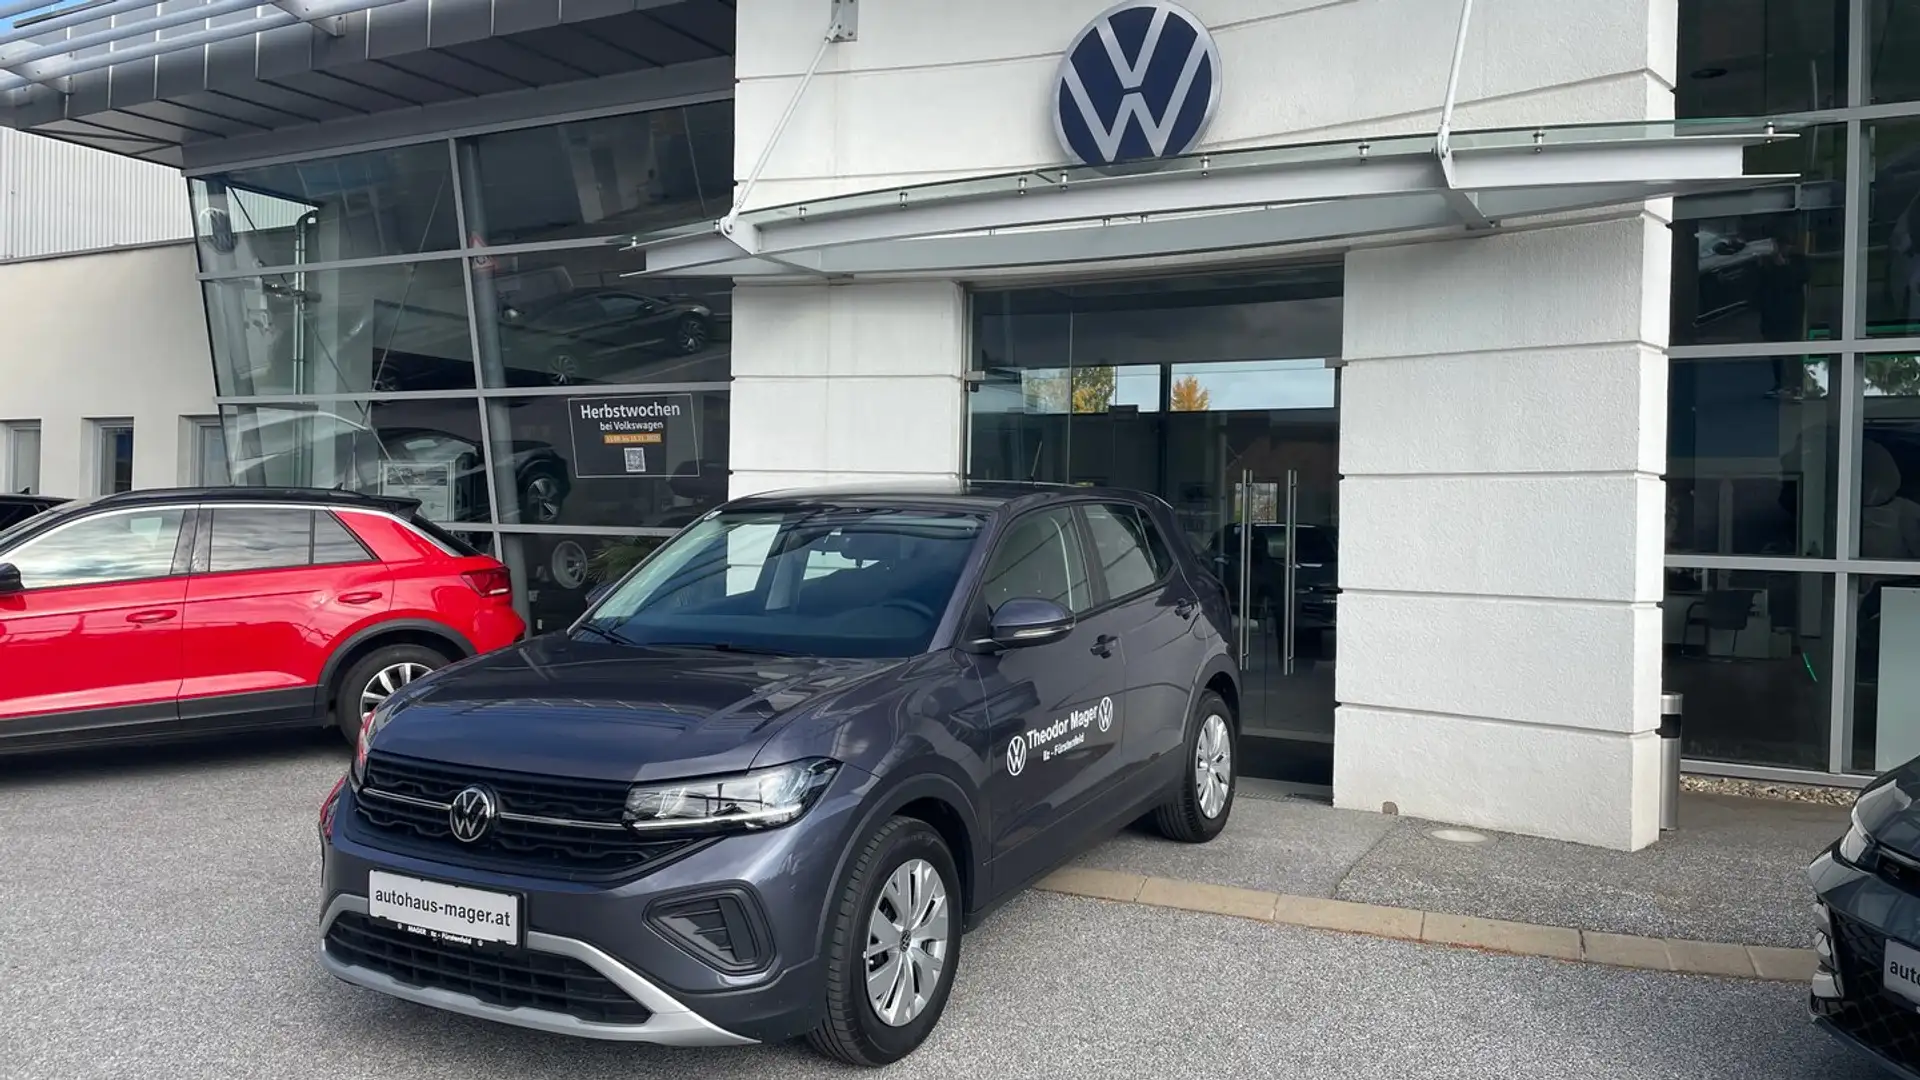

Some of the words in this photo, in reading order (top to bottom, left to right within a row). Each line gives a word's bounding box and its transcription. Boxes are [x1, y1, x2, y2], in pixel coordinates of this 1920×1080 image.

[580, 401, 680, 419] Herbstwochen
[600, 421, 612, 431] bei
[614, 421, 663, 431] Volkswagen
[1027, 719, 1069, 749] Theodor
[1070, 705, 1098, 730] Mager
[375, 889, 511, 926] autohaus-mager.at
